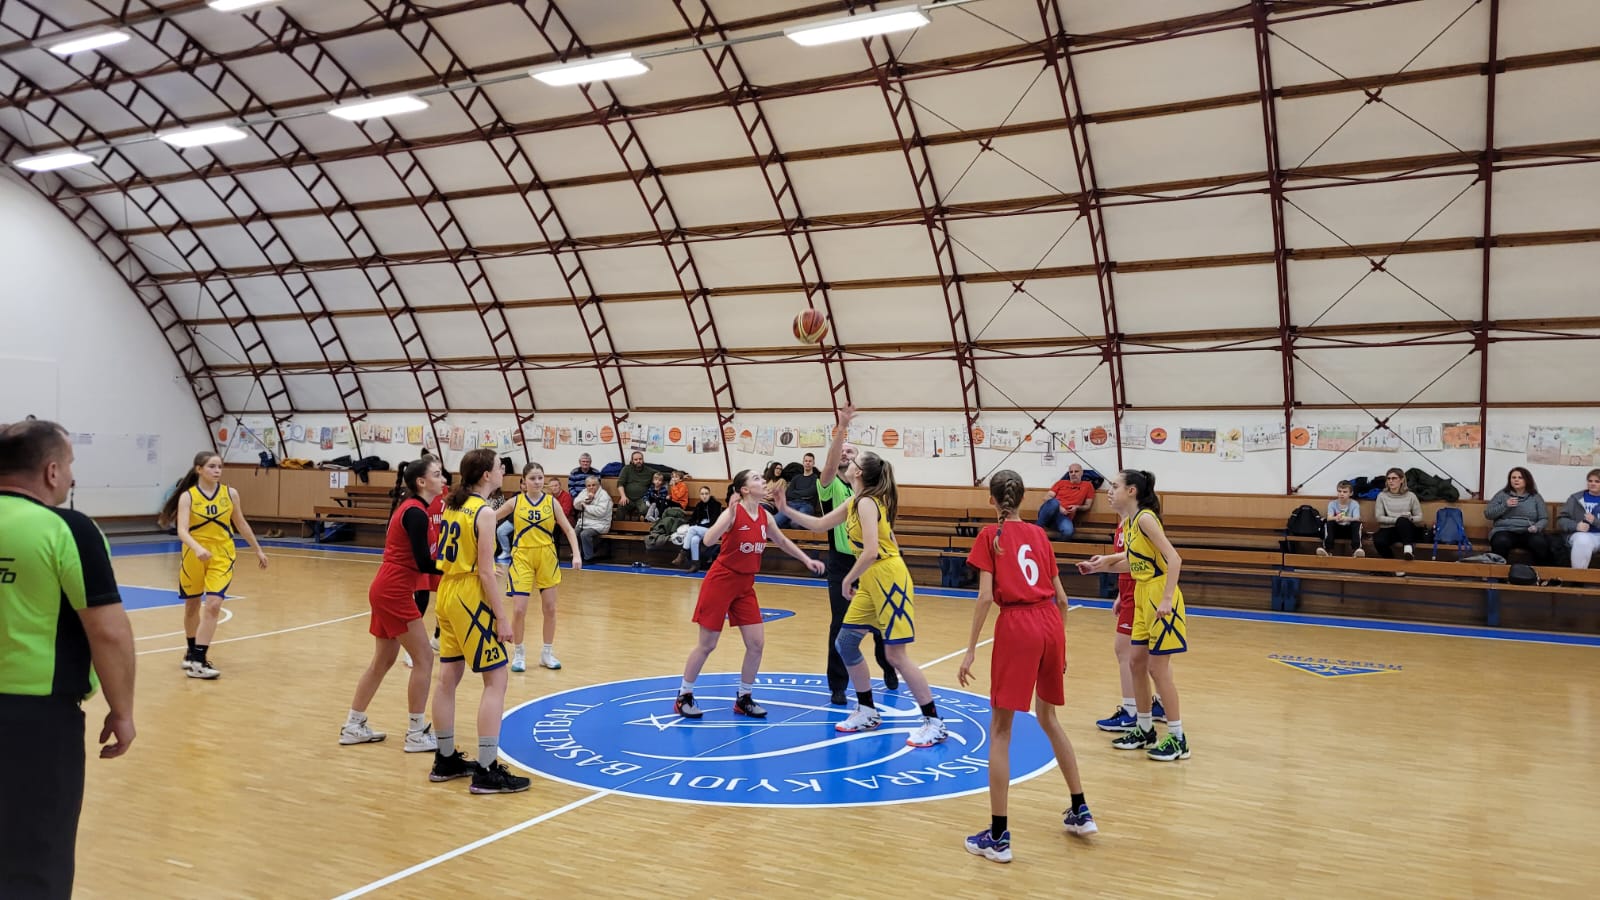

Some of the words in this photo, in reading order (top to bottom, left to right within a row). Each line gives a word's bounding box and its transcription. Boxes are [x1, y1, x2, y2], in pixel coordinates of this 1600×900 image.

[205, 504, 218, 515] 10
[527, 510, 542, 521] 35
[437, 519, 461, 563] 23
[1017, 543, 1040, 587] 6
[484, 646, 500, 662] 23
[533, 702, 643, 776] BASKETBALL
[645, 772, 822, 793] KYJOV
[843, 754, 990, 789] JISKRA
